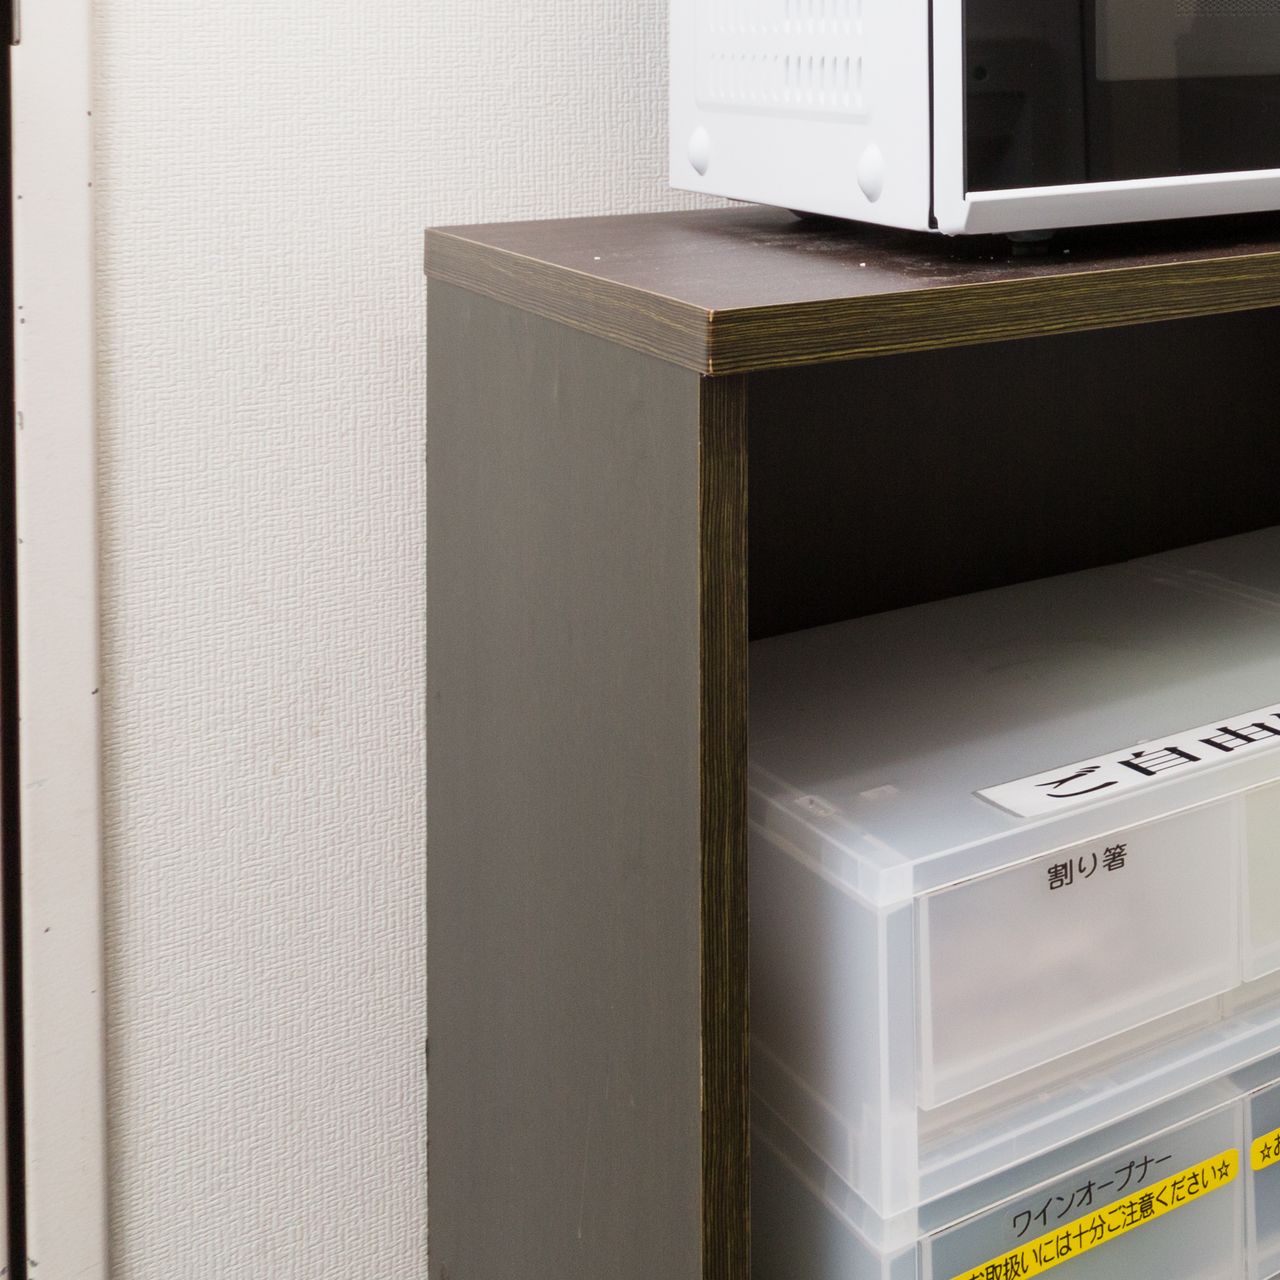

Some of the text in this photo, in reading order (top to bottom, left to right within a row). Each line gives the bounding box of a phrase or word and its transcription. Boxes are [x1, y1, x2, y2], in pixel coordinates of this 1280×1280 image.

[1046, 843, 1130, 893] 割り箸
[1013, 1153, 1173, 1238] ワインオープナー
